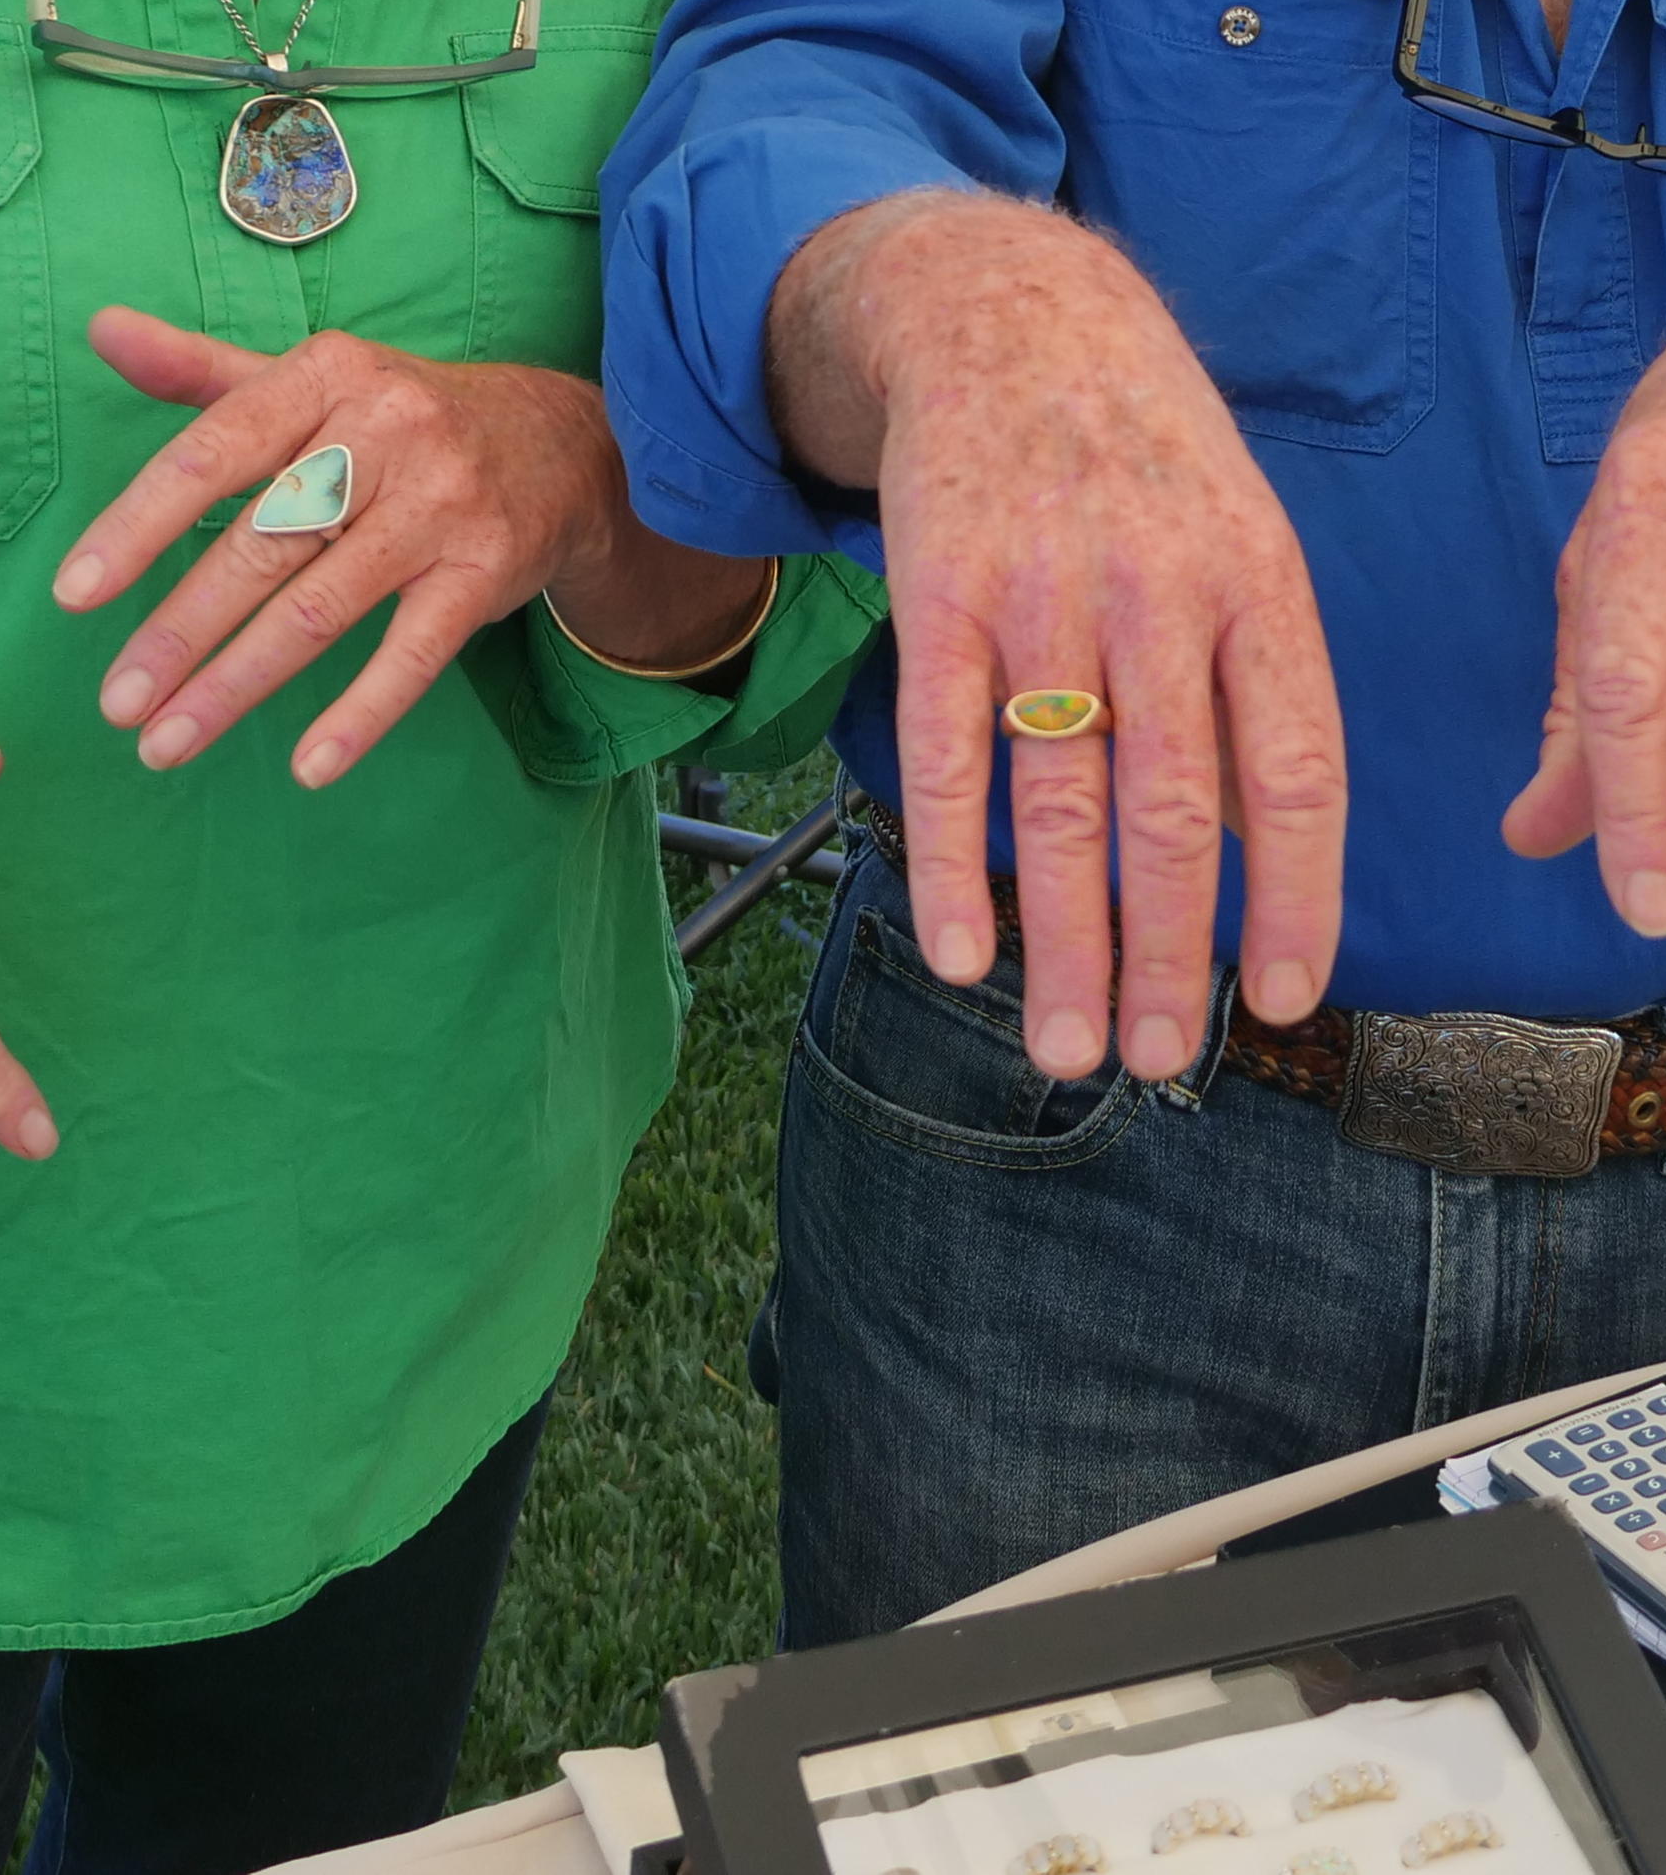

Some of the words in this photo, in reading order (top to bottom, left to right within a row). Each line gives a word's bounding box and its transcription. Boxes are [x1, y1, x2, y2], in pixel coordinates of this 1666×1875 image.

[1642, 1428, 1657, 1440] 2
[1600, 1443, 1616, 1455] 3
[1623, 1460, 1637, 1473] 6
[1647, 1478, 1662, 1490] 9
